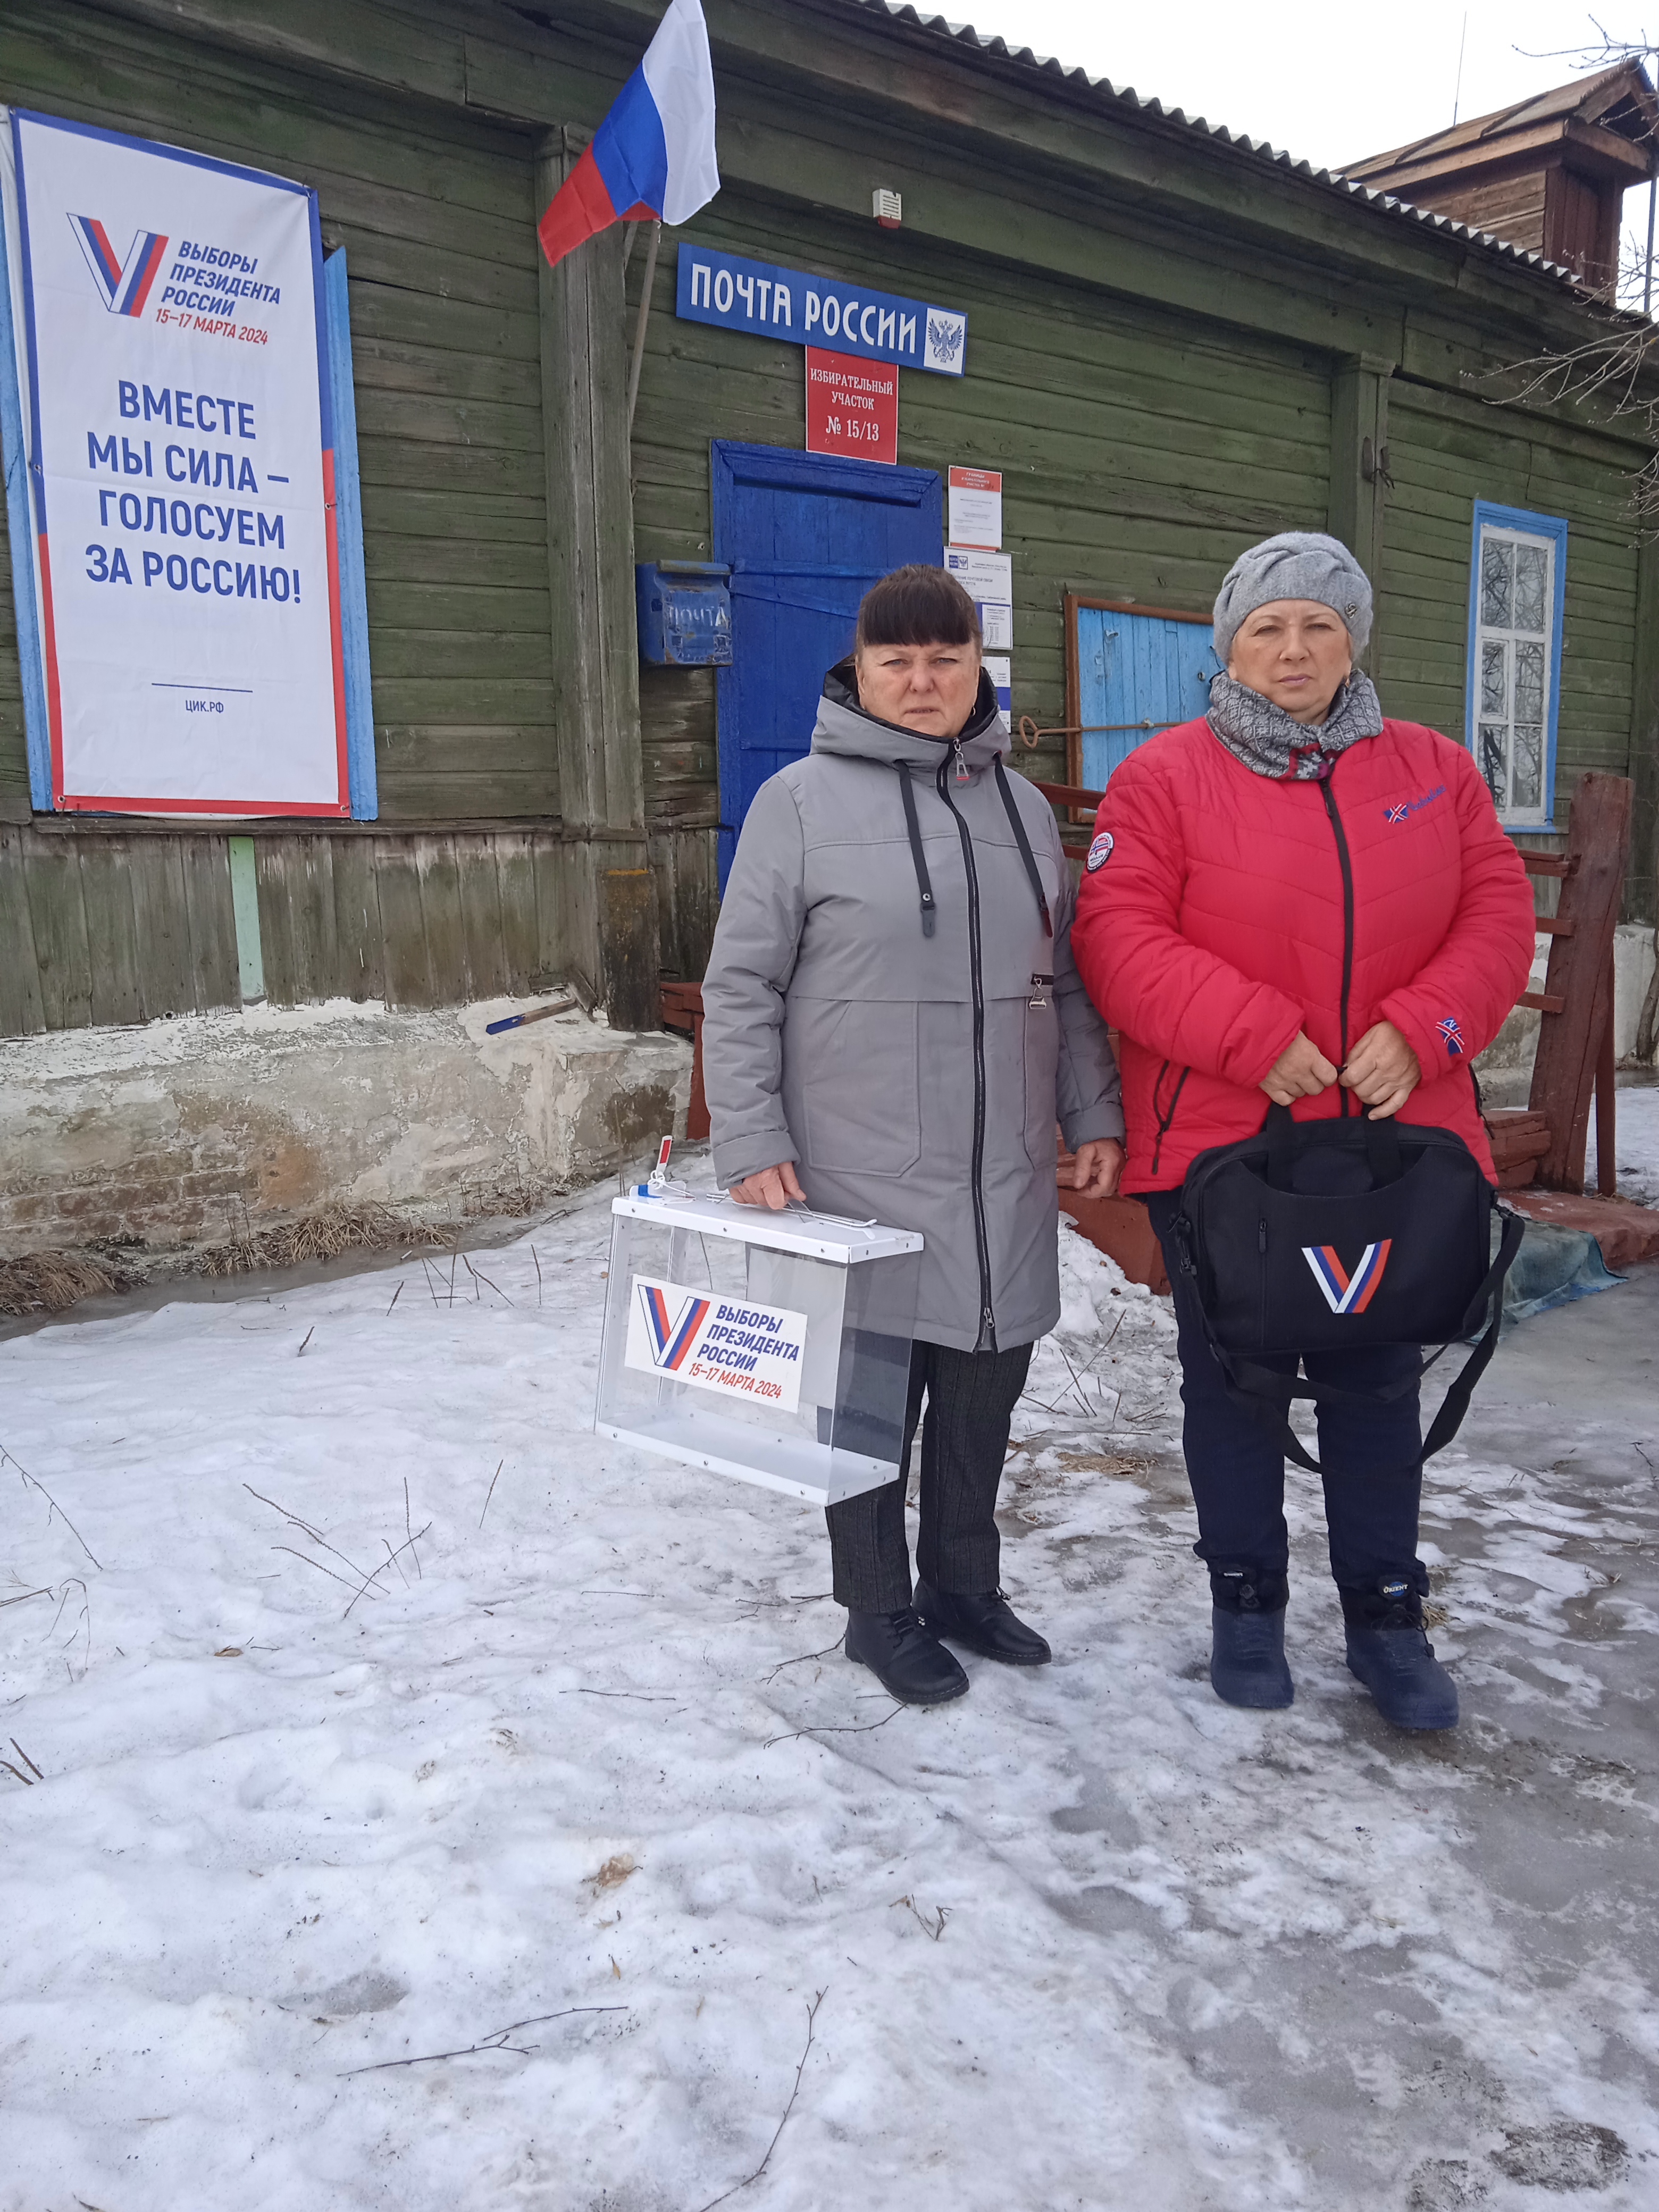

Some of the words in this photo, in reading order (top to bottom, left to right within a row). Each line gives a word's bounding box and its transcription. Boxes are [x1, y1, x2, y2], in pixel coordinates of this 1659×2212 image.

[178, 240, 258, 274] ВЫБОРЫ
[170, 263, 281, 305] ПРЕЗИДЕНТА
[161, 286, 236, 317] РОССИИ
[691, 263, 792, 326] ПОЧТА
[805, 290, 916, 354] РОССИИ
[194, 316, 237, 339] МАРТА
[238, 326, 268, 345] 2024
[810, 367, 893, 396] ИЗБИРАТЕЛЬНЫЙ
[119, 380, 257, 440] ВМЕСТЕ
[831, 391, 875, 410] УЧАСТОК
[825, 415, 841, 435] №
[846, 420, 879, 441] 15/13
[87, 431, 153, 478] МЫ
[165, 445, 258, 493] СИЛА
[99, 489, 286, 549] ГОЛОСУЕМ
[85, 544, 132, 584] ЗА
[143, 550, 301, 604] РОССИЮ!
[186, 700, 224, 713] ЦИК.РФ
[716, 1304, 783, 1334] ВЫБОРЫ
[697, 1344, 758, 1371] РОССИИ
[707, 1324, 800, 1361] ПРЕЗИДЕНТА
[718, 1370, 754, 1391] МАРТА
[755, 1380, 782, 1399] 2024
